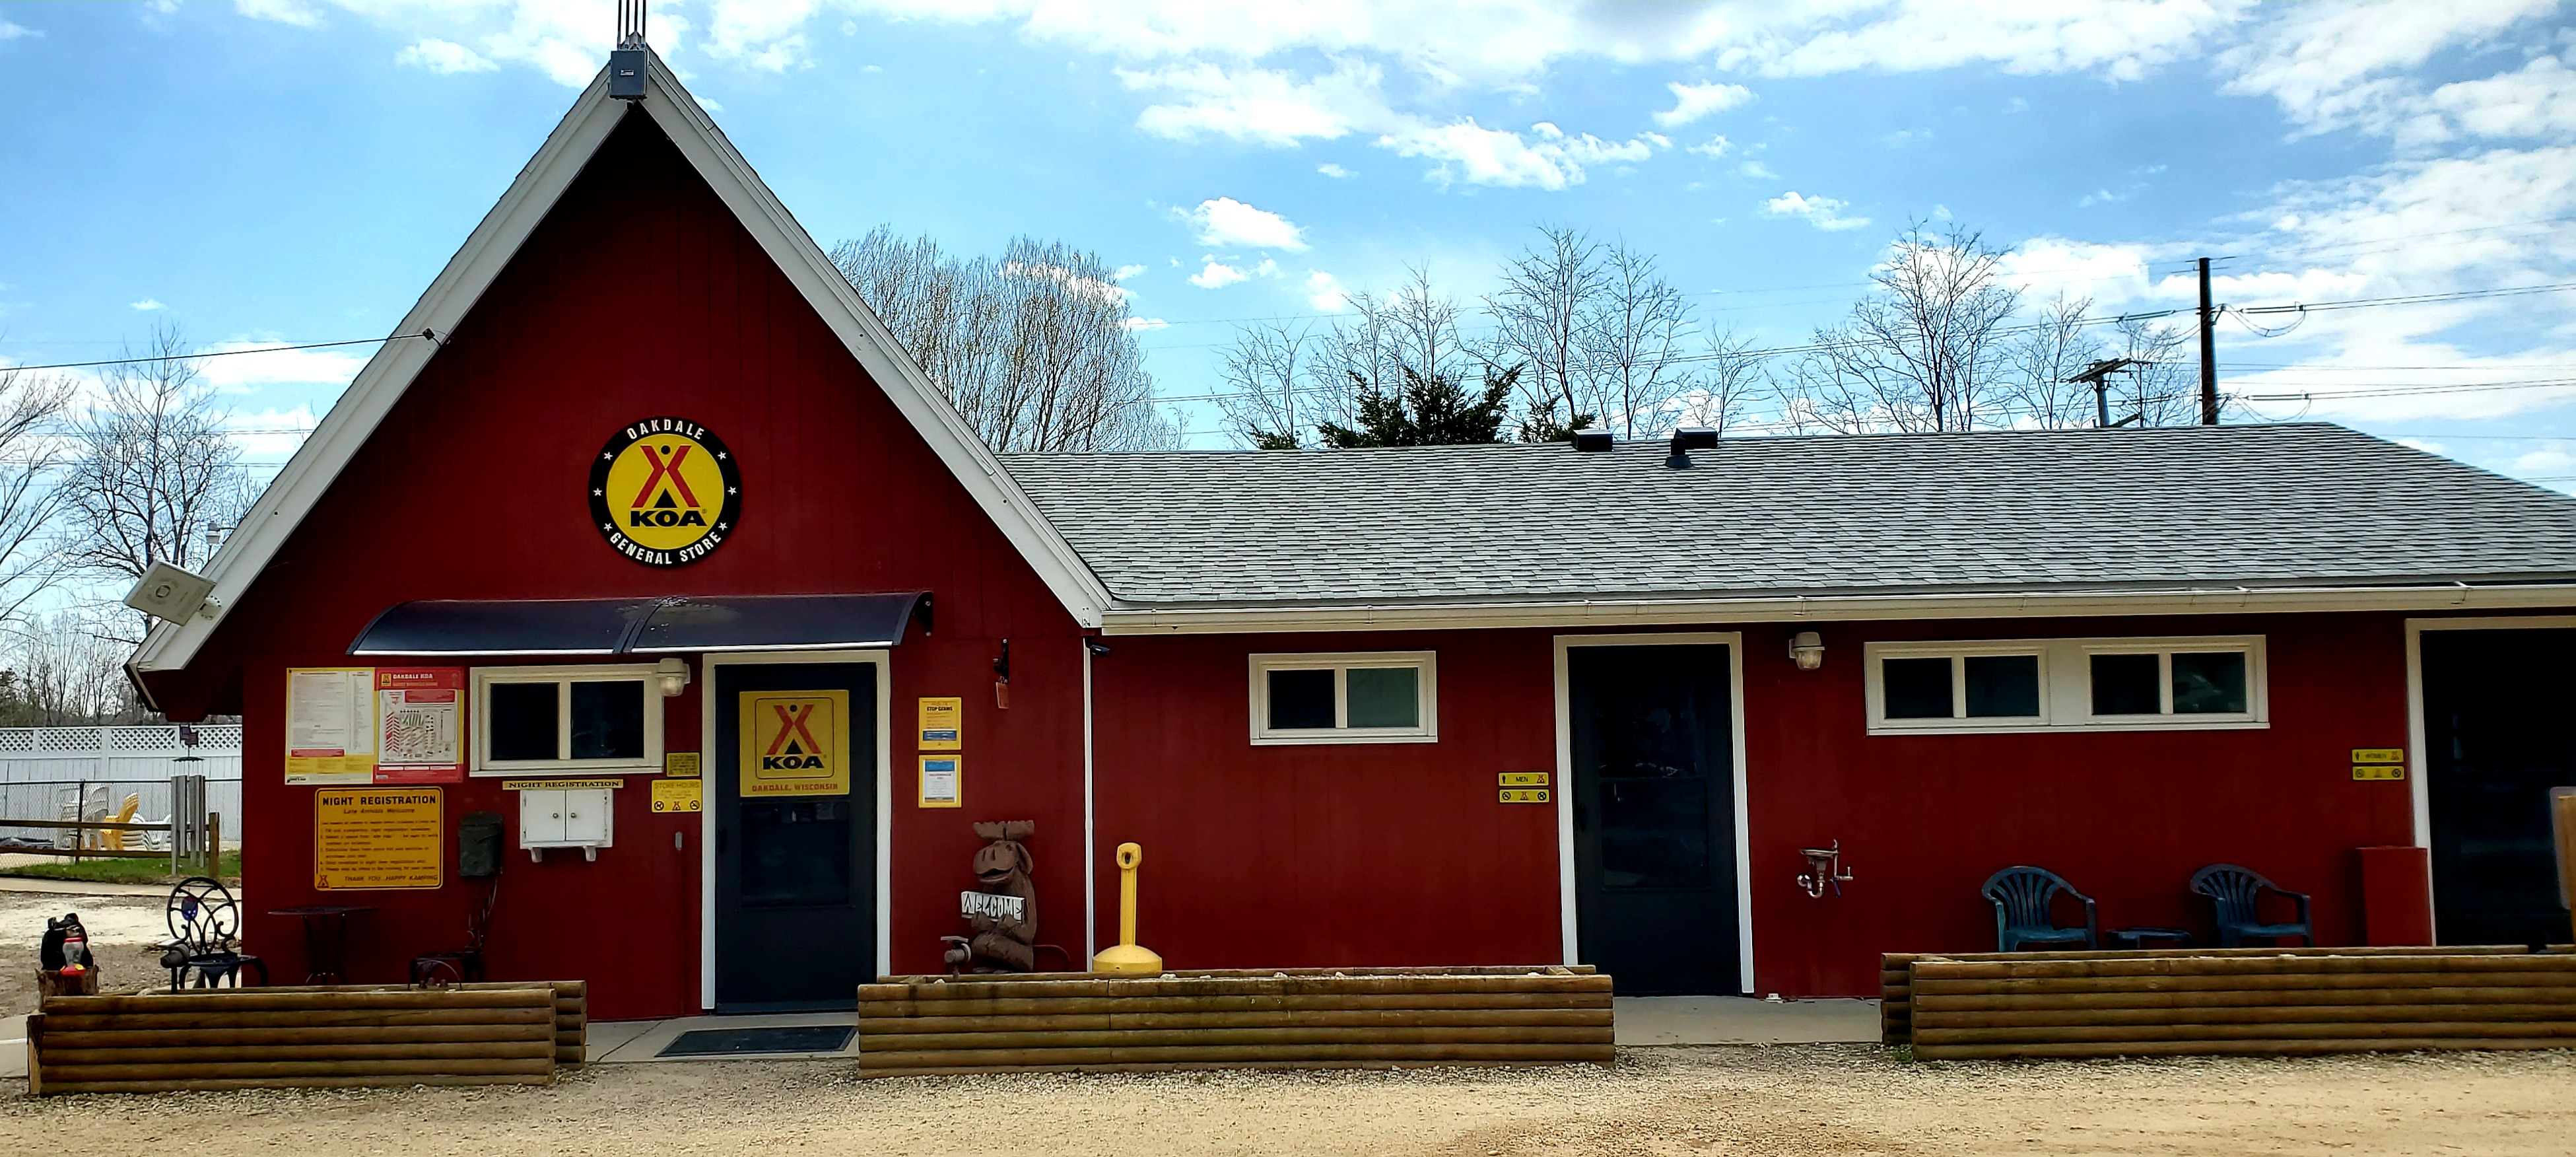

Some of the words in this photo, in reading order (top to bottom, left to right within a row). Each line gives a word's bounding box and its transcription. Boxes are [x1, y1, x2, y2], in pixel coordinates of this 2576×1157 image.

[627, 419, 704, 440] OAKDALE
[630, 510, 708, 527] KOA
[610, 532, 672, 565] GENERAL
[679, 531, 722, 562] STORE
[763, 755, 825, 770] KOA
[322, 796, 354, 806] NIGHT
[360, 795, 436, 805] REGISTRATION
[962, 892, 1023, 923] WELCOME
